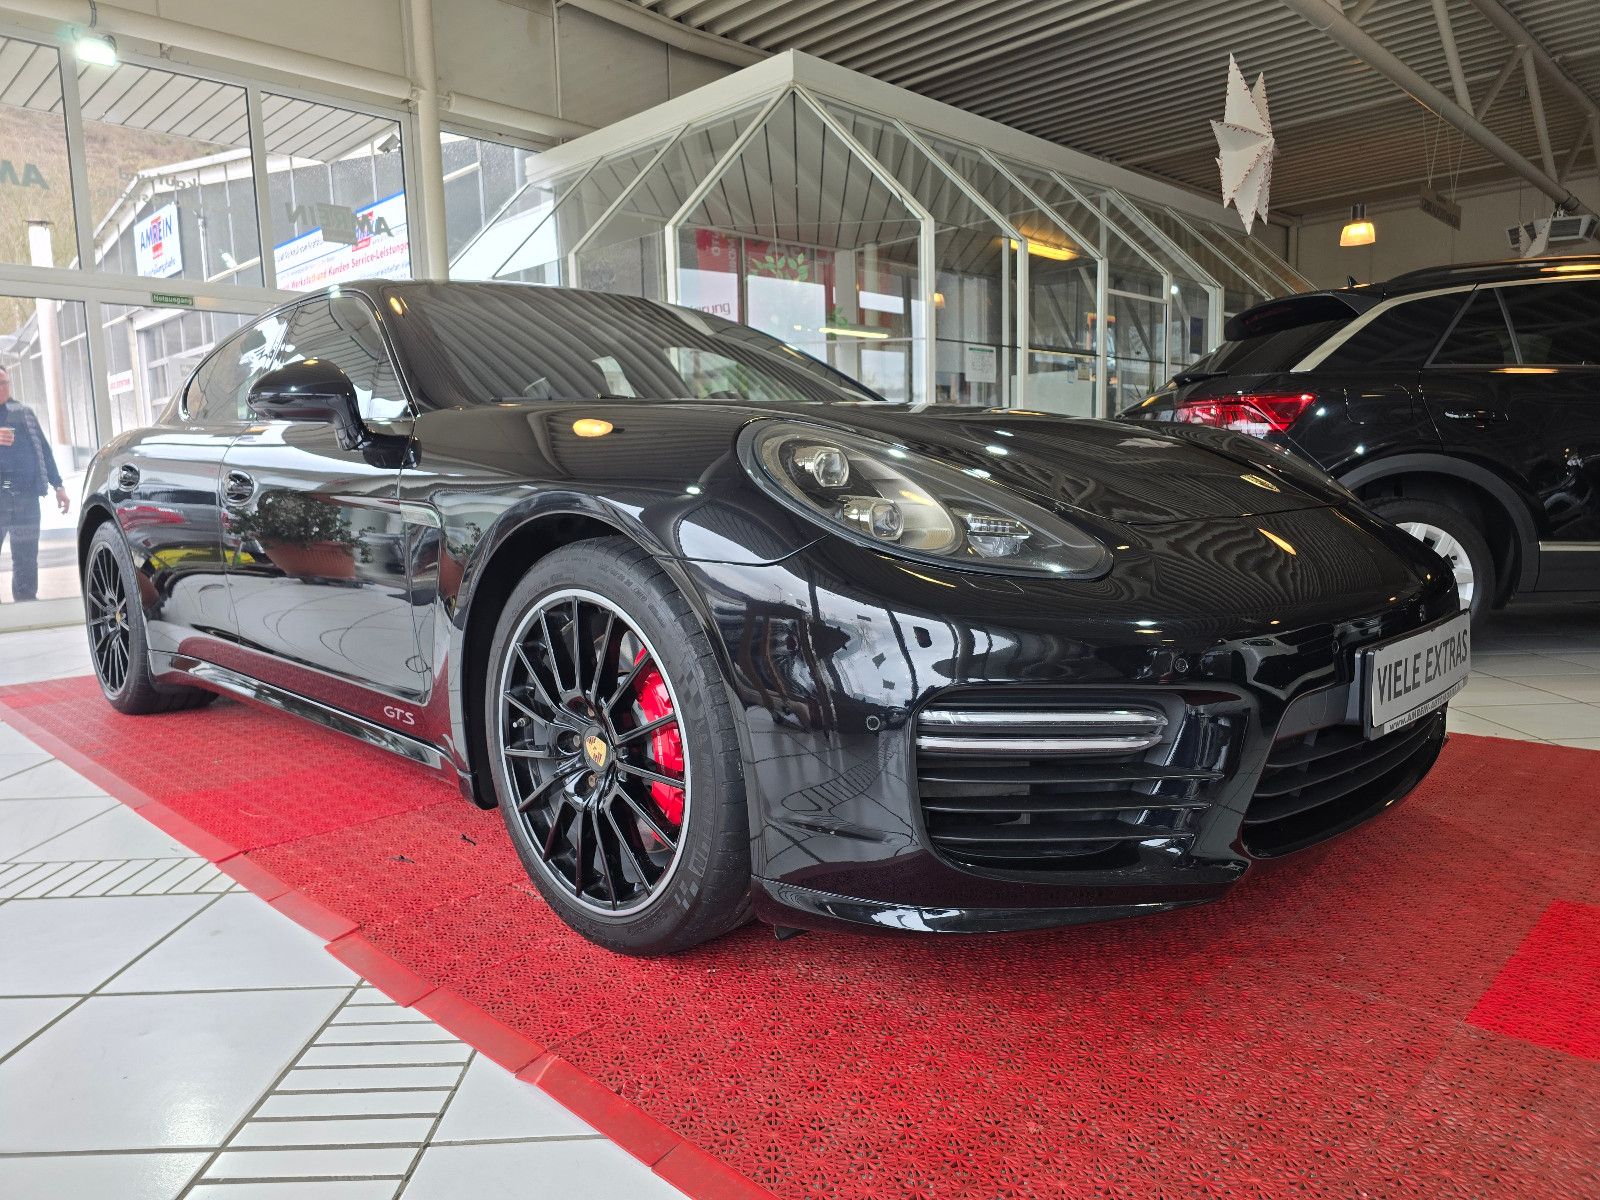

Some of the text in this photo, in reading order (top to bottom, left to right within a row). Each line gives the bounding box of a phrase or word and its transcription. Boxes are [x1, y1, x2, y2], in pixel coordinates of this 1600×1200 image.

[141, 213, 172, 252] AMREIN
[1377, 629, 1467, 706] VIELE EXTRAS
[383, 705, 415, 726] GTS
